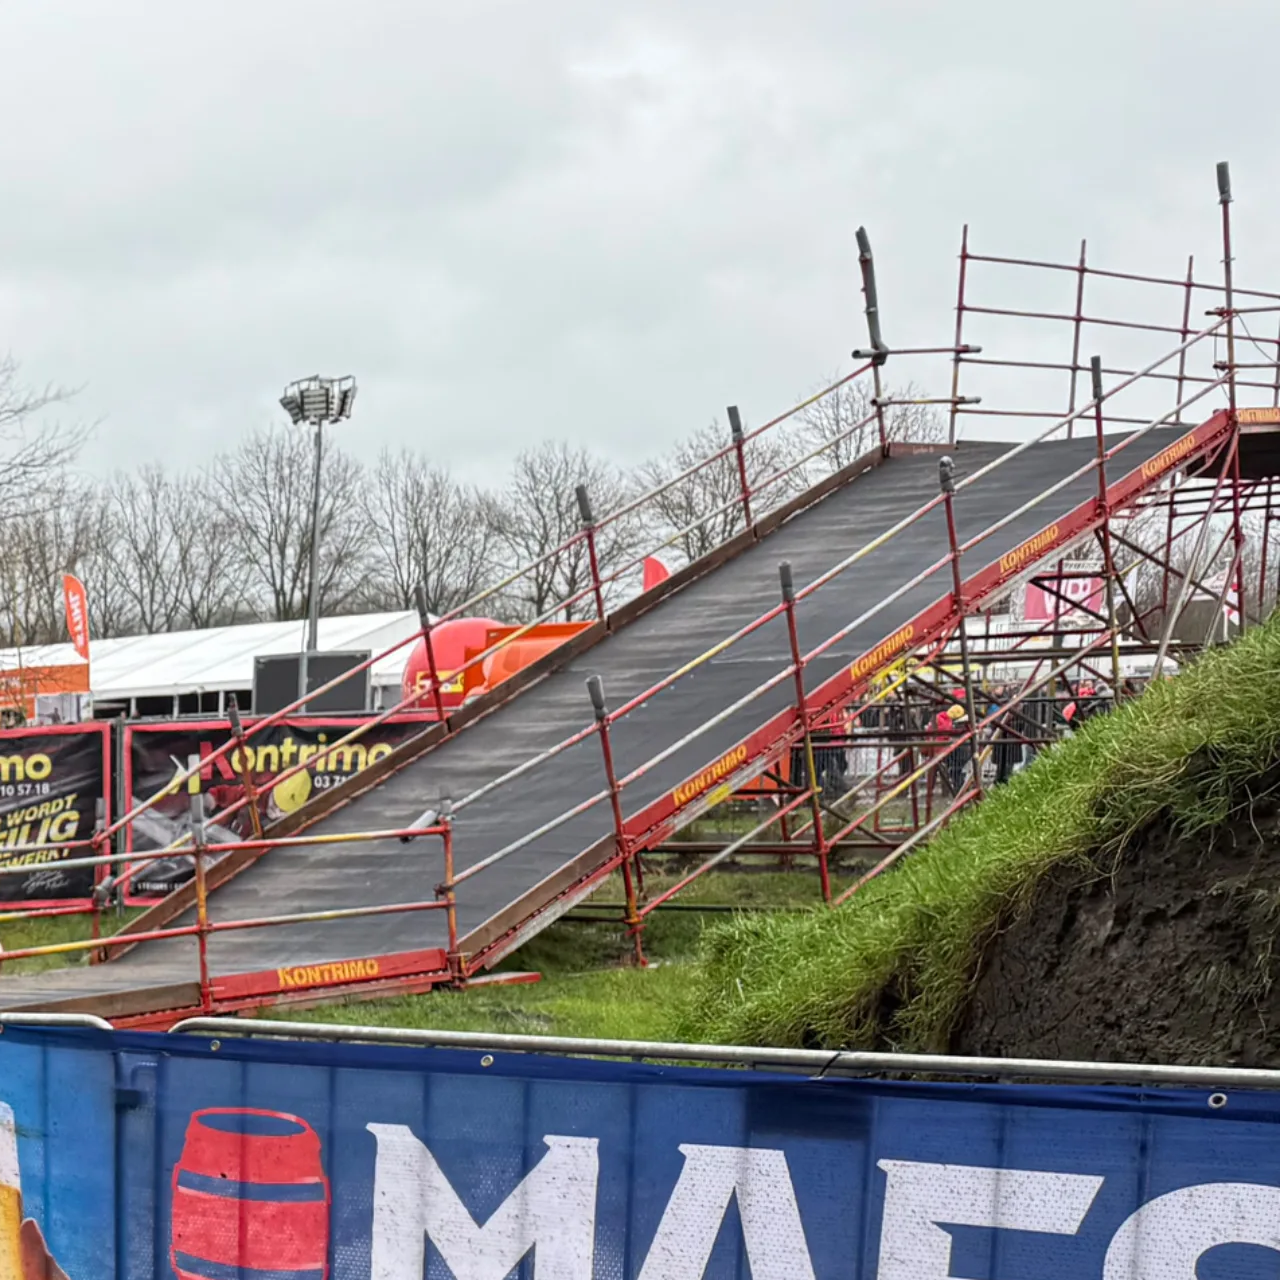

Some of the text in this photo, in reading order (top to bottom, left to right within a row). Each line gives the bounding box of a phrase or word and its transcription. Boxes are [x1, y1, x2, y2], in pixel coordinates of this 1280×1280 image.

[1140, 434, 1196, 479] KONTRIMO
[999, 525, 1059, 573] KONTRIMO
[850, 624, 914, 680] KONTRIMO
[17, 784, 32, 796] 57
[34, 783, 51, 795] 18
[313, 775, 330, 788] 03
[673, 745, 747, 805] KONTRIMO
[6, 793, 78, 827] WORDT
[277, 958, 380, 988] KONTRIMO
